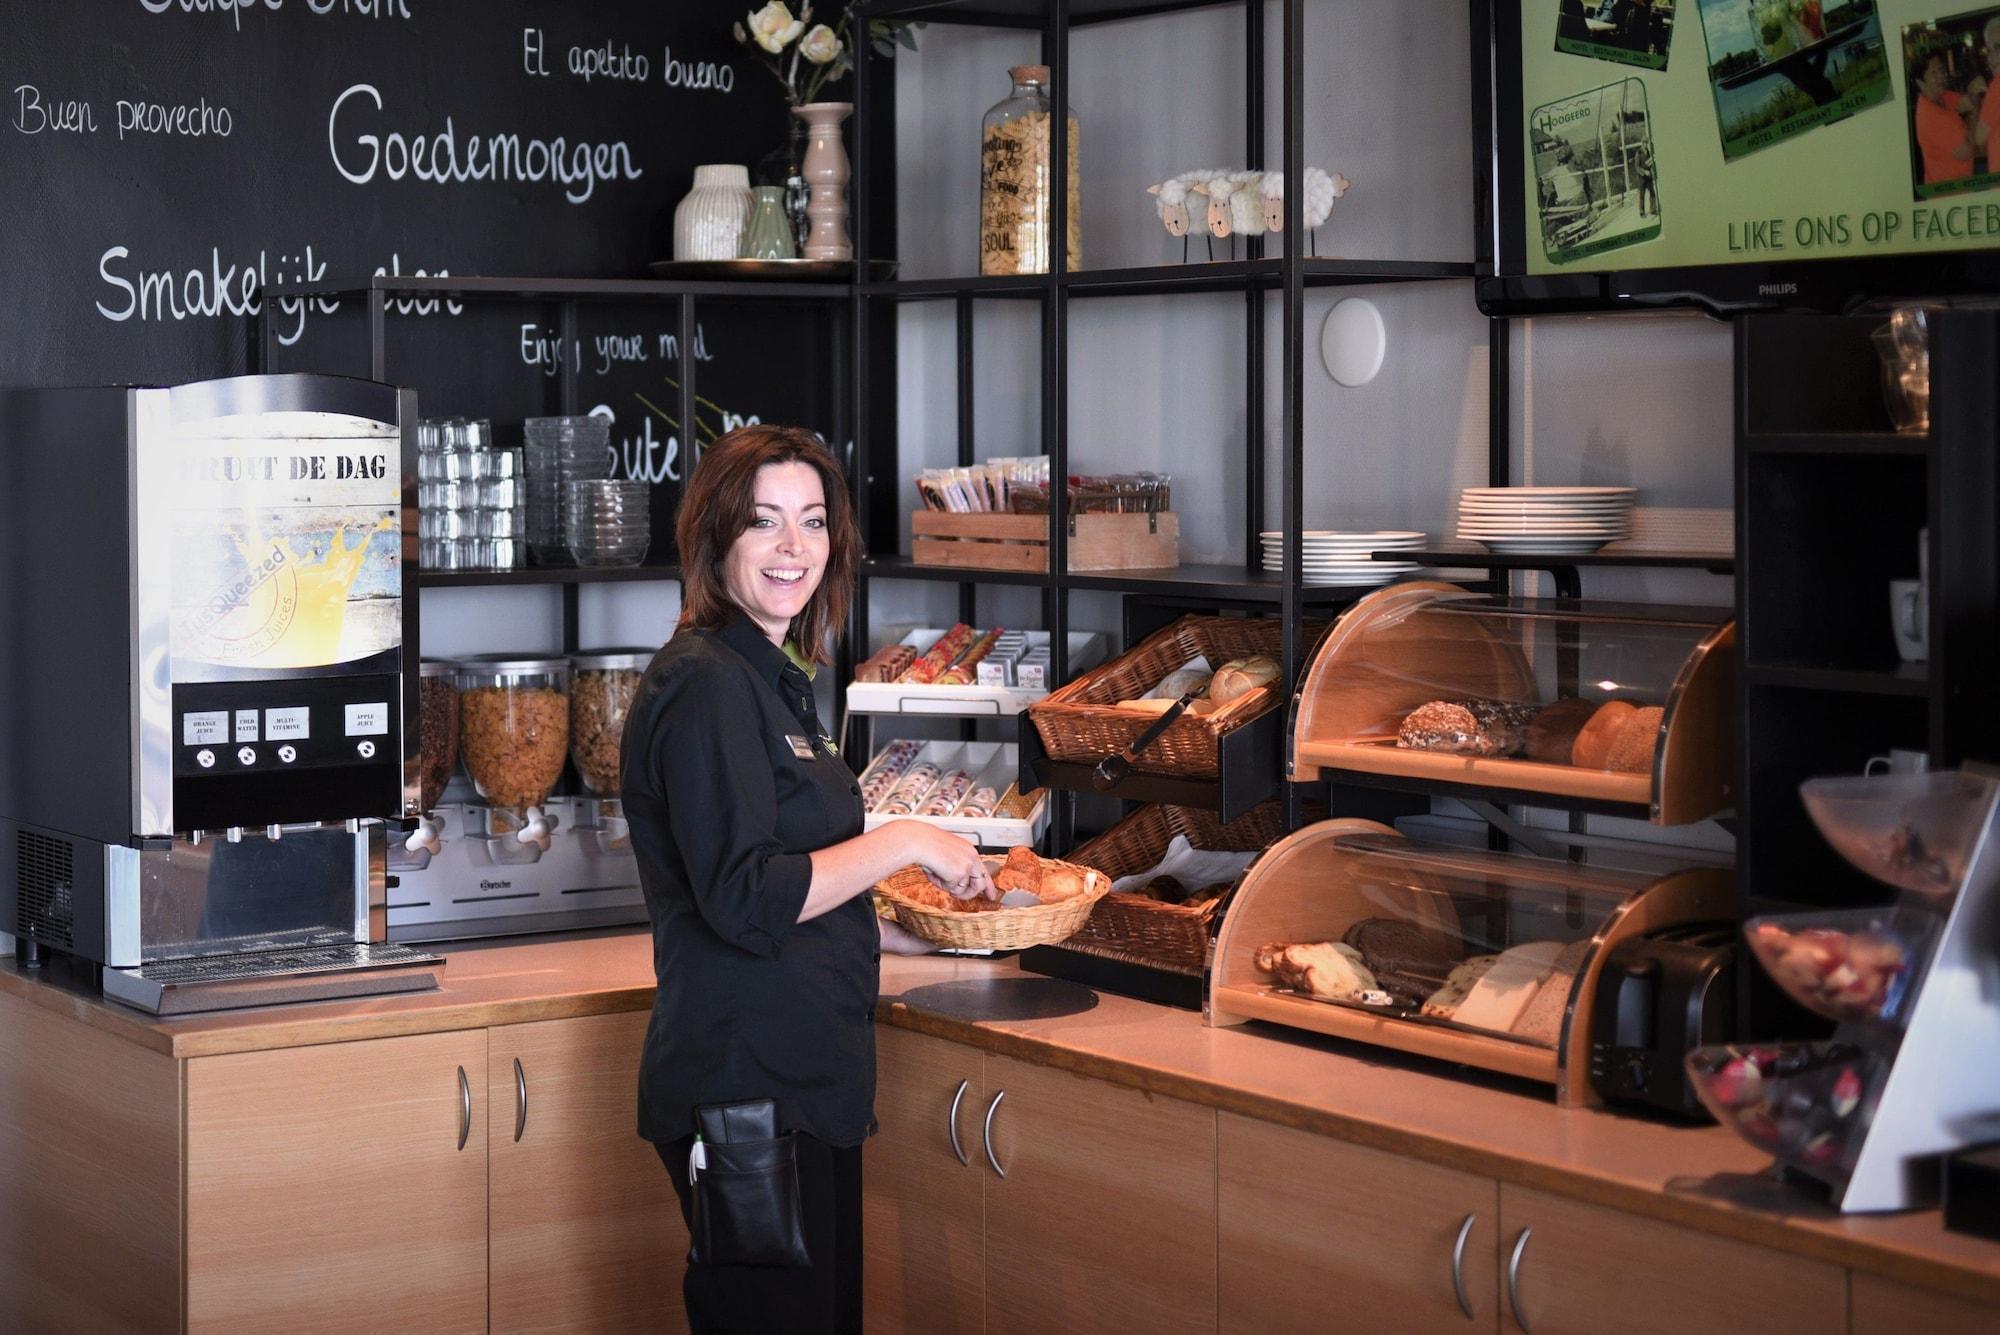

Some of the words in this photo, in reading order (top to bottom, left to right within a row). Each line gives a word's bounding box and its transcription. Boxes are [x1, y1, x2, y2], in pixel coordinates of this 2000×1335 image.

[523, 27, 550, 77] El
[567, 39, 650, 83] apetito
[664, 45, 735, 92] bueno
[12, 84, 97, 134] Buen
[116, 97, 232, 140] provecho
[1539, 107, 1591, 132] HOOGEERD
[328, 83, 643, 204] Goedemorgen
[984, 230, 1015, 253] SOUL
[1728, 218, 1785, 250] LIKE
[1795, 214, 1850, 246] ONS
[1862, 211, 1900, 242] OP
[1913, 204, 2000, 240] FACEB
[1758, 283, 1798, 296] PHILIPS
[595, 334, 648, 375] your
[289, 455, 326, 480] DE
[336, 454, 386, 480] DAG
